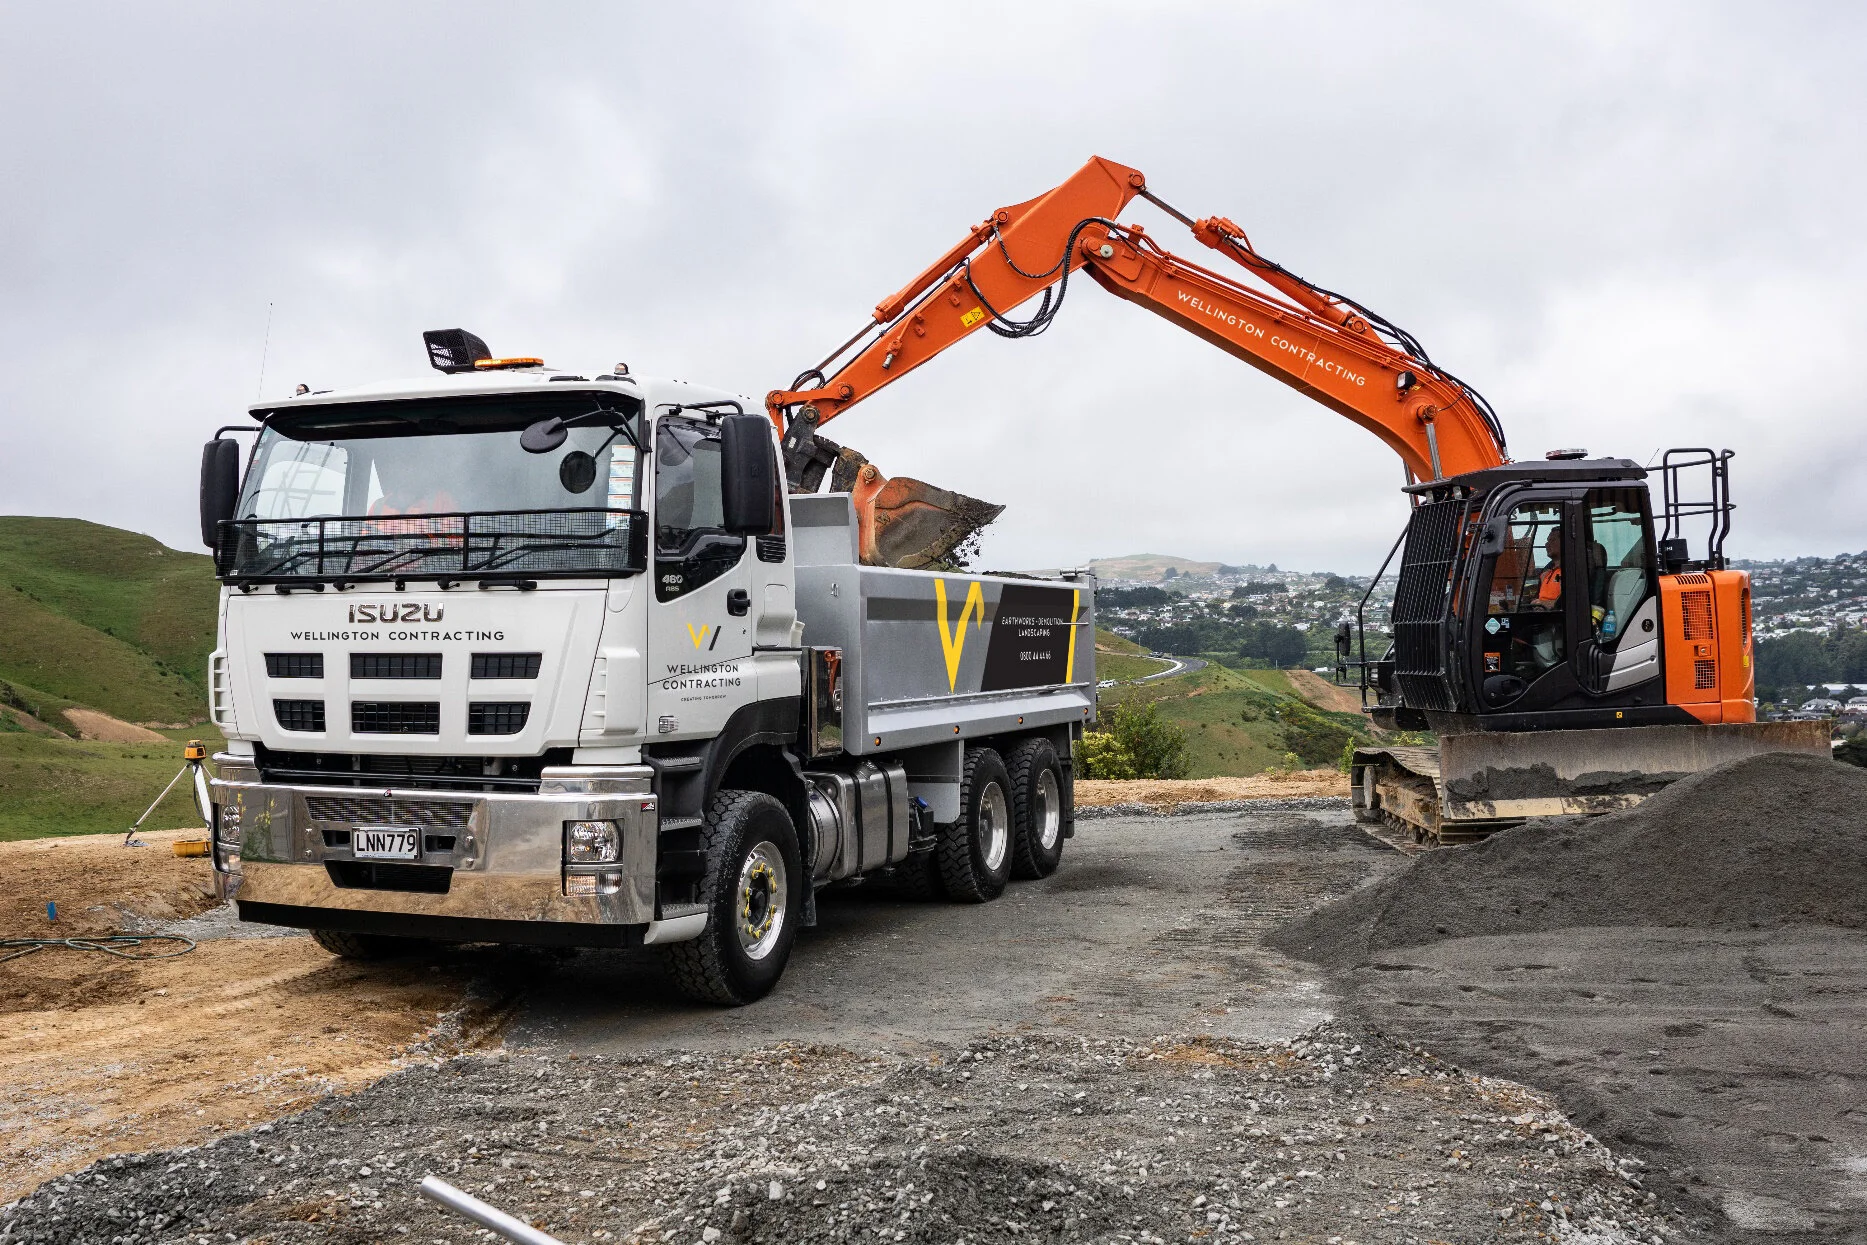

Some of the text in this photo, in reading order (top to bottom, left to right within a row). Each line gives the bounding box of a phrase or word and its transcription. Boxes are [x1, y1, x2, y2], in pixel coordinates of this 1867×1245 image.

[1178, 290, 1366, 386] WELLINGTON CONTRACTING
[348, 602, 444, 623] ISUZU
[1002, 617, 1035, 625] EARTHWORKS
[290, 631, 505, 641] WELLINGTON CONTRACTING
[666, 664, 739, 674] WELLINGTON
[662, 678, 741, 690] CONTRACTING
[356, 833, 416, 852] LNN779
